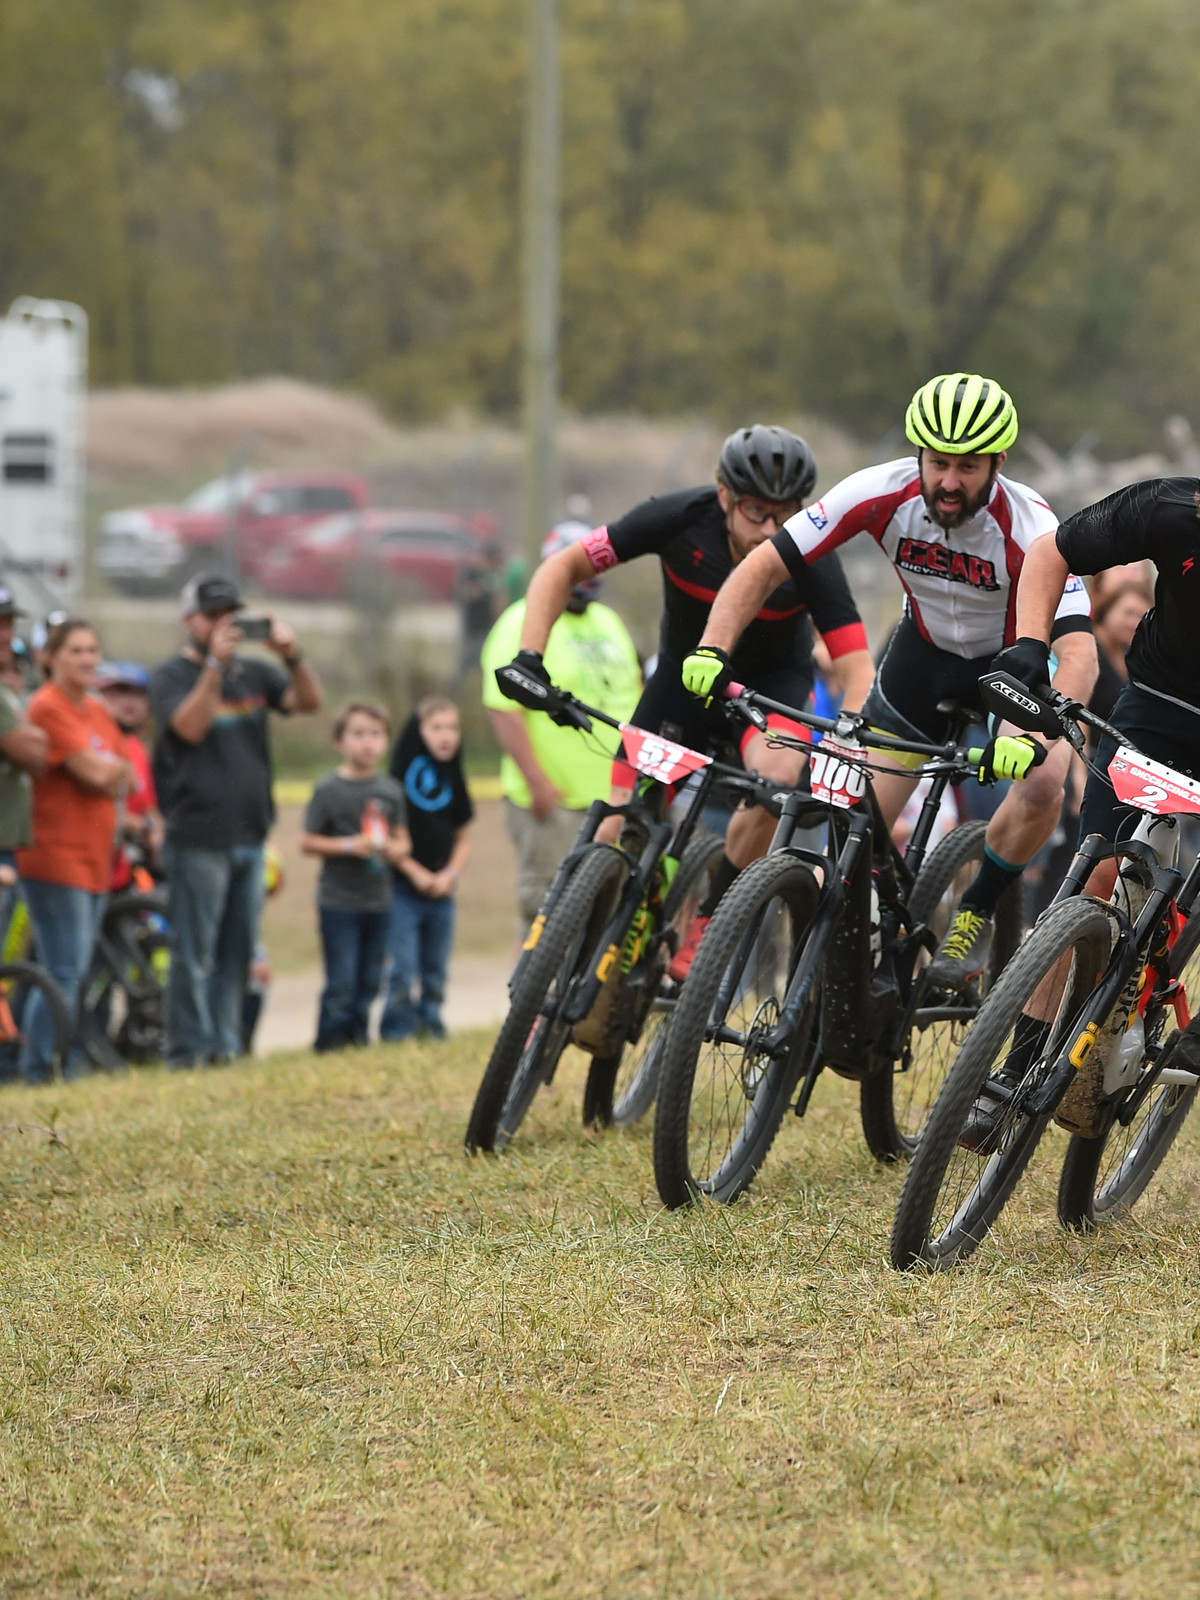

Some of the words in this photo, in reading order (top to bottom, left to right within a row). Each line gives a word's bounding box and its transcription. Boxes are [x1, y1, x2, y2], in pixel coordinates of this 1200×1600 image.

[900, 539, 996, 586] GEAR
[991, 682, 1039, 713] ACERBIS
[810, 751, 866, 797] 100
[1131, 784, 1169, 808] 2
